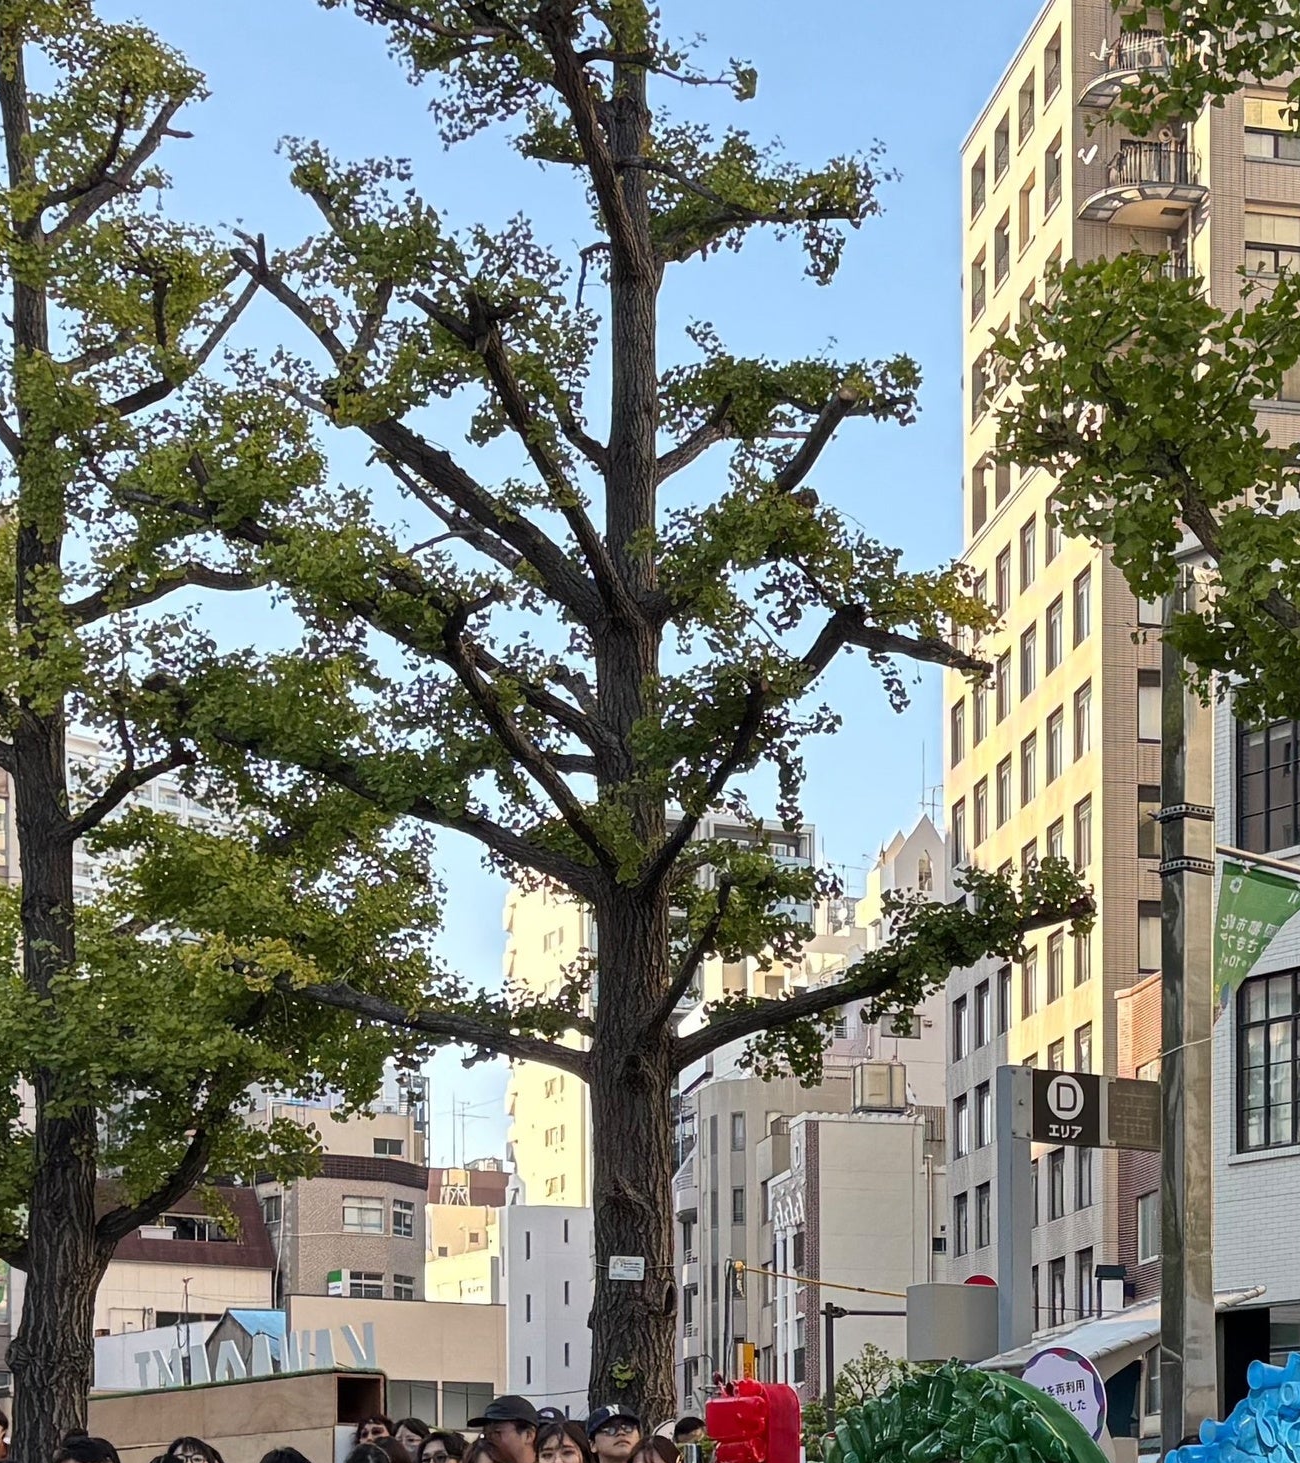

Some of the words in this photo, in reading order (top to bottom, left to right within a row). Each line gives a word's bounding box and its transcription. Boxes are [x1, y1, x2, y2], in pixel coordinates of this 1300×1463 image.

[1056, 1082, 1077, 1112] D
[1048, 1124, 1082, 1139] エリア
[1041, 1379, 1086, 1396] を再利用
[605, 1403, 620, 1416] N
